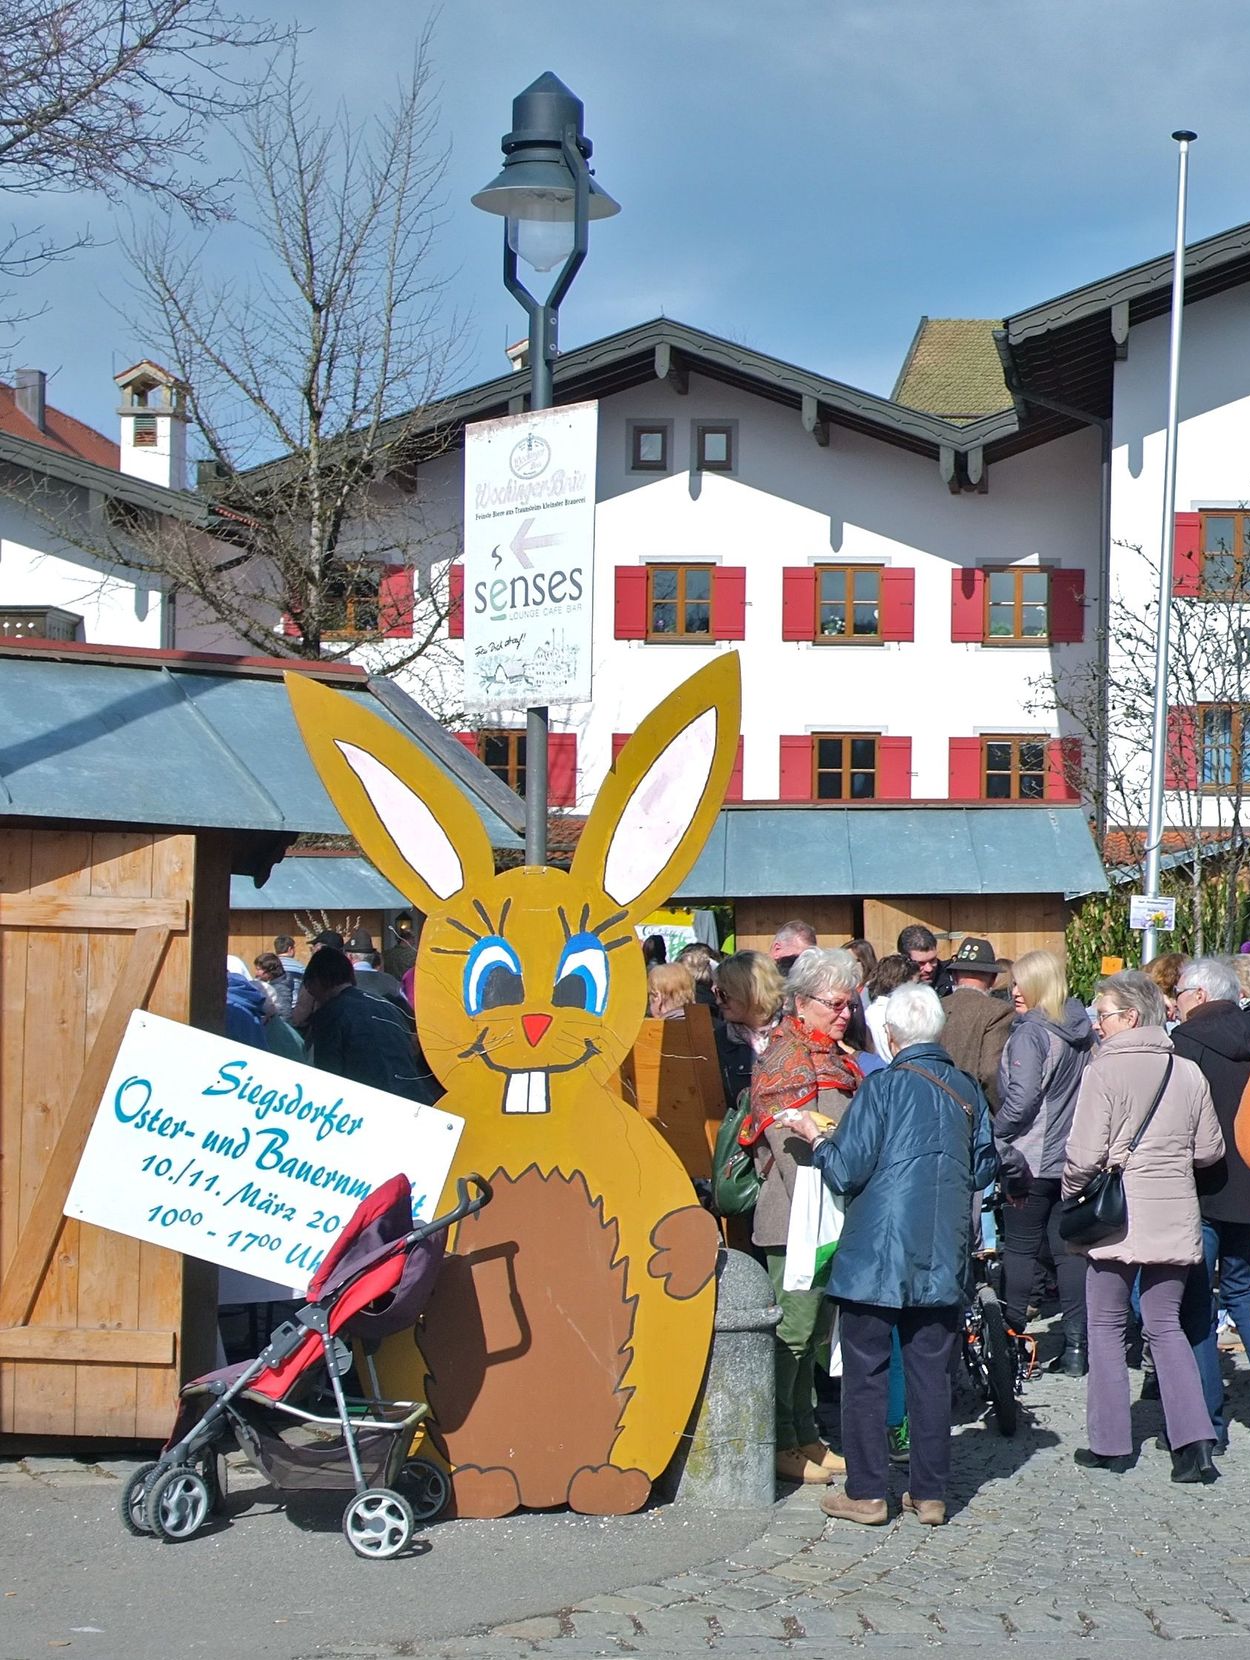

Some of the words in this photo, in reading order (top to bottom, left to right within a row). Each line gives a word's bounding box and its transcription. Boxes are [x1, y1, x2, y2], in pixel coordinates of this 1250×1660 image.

[474, 567, 583, 614] senses
[509, 608, 540, 621] LOUNGE
[566, 603, 583, 614] BAR
[202, 1060, 364, 1143] Siegsdorfer
[114, 1075, 196, 1139] Oster-
[201, 1128, 252, 1160] und
[255, 1127, 429, 1219] Bauernmt
[141, 1154, 222, 1198] 10./11.
[222, 1181, 299, 1223] März
[285, 1242, 325, 1276] Uh
